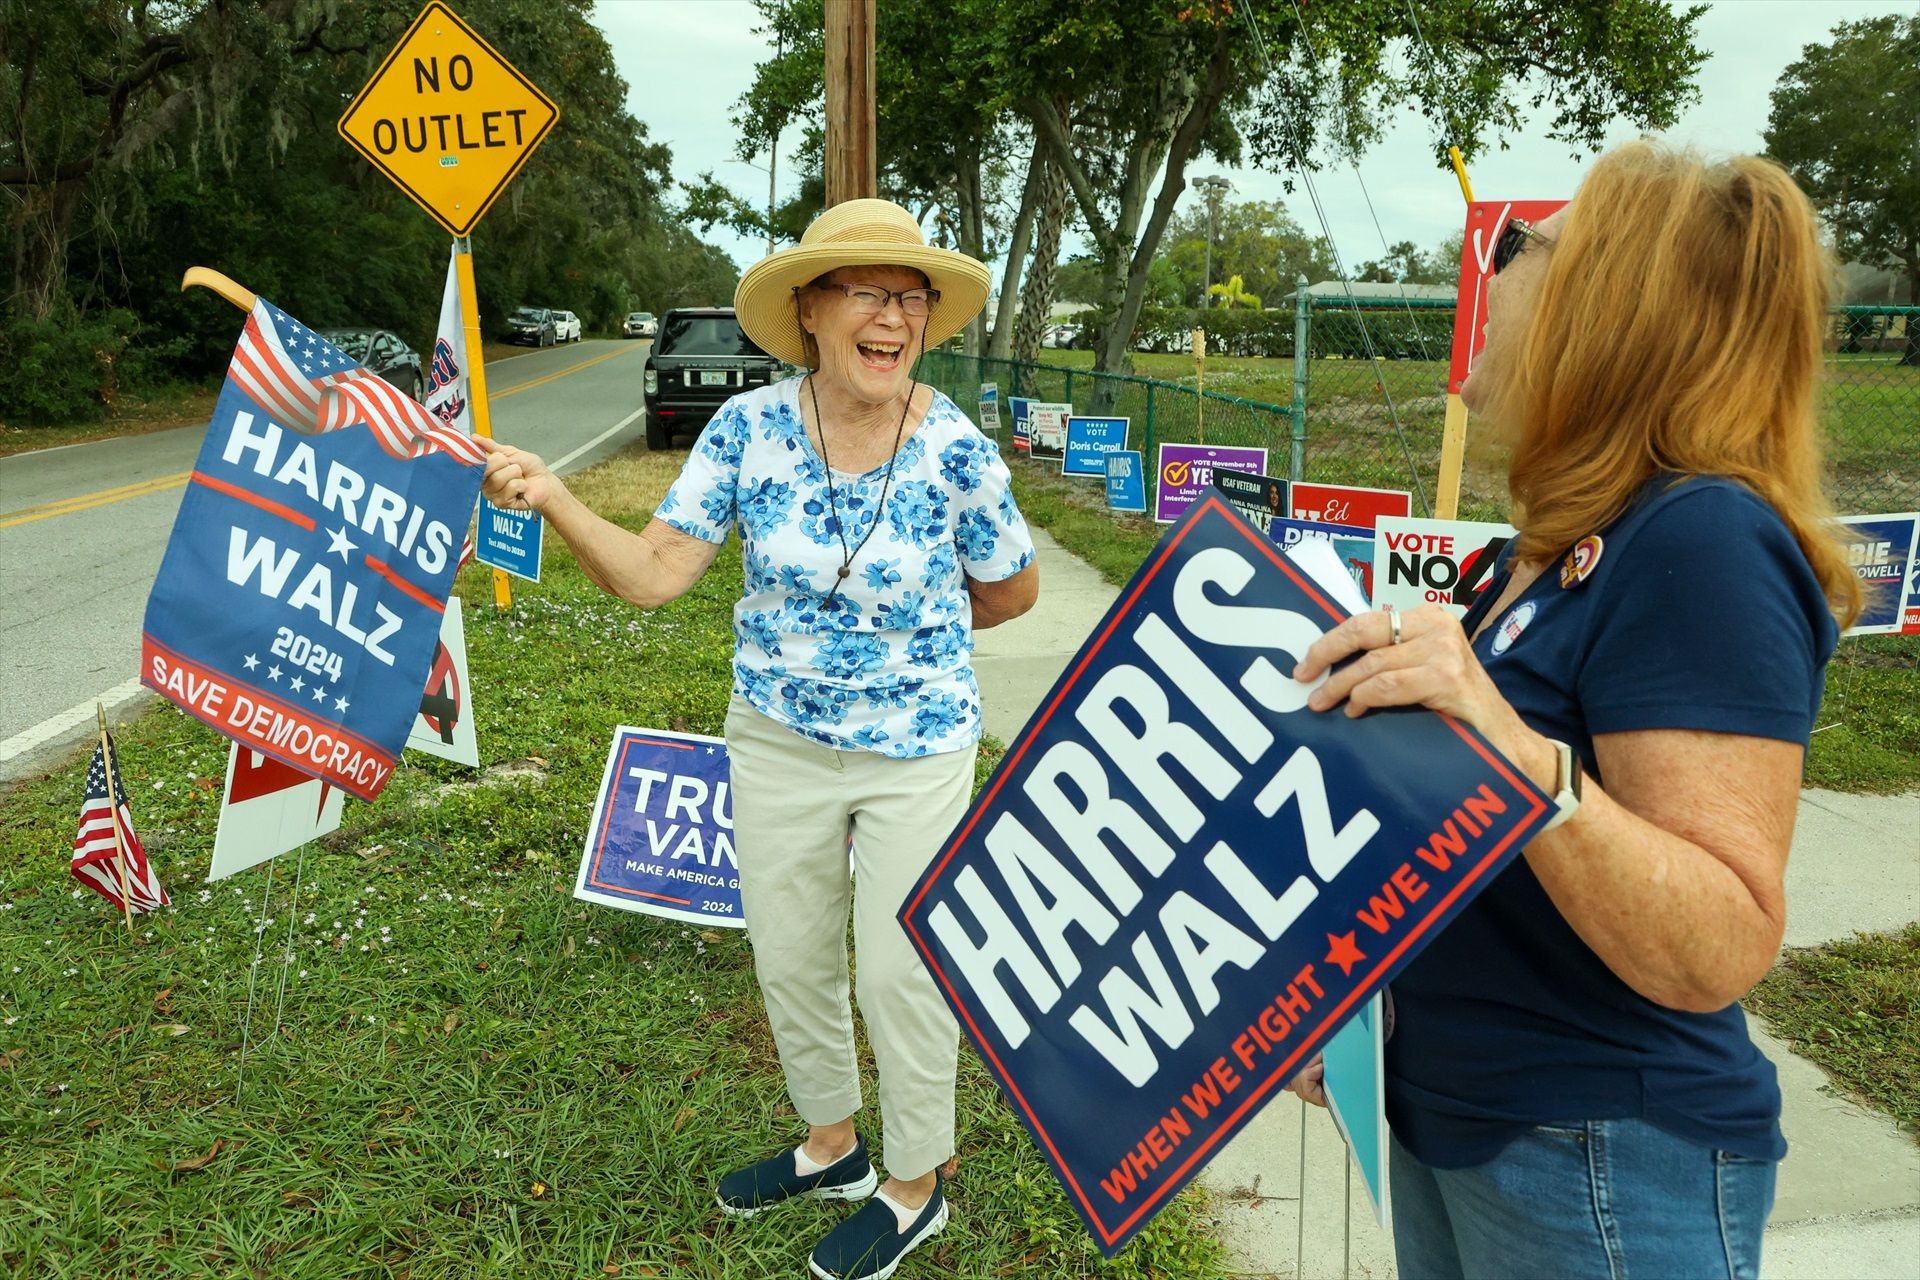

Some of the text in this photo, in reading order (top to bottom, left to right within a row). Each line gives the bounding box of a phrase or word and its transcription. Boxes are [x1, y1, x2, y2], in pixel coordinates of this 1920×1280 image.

[413, 54, 473, 94] NO
[373, 109, 527, 155] OUTLET
[1070, 441, 1121, 452] Doris Carroll
[222, 409, 453, 576] HARRIS
[1222, 477, 1261, 494] USAF VETERAN
[493, 514, 524, 541] WALZ
[1323, 499, 1350, 521] Ed
[1384, 531, 1454, 555] VOTE
[1388, 551, 1459, 591] NO
[227, 525, 404, 668] WALZ
[1424, 590, 1452, 605] ON
[270, 626, 344, 684] 2024
[152, 654, 390, 792] SAVE DEMOCRACY
[927, 547, 1332, 1050] HARRIS
[625, 858, 663, 877] MAKE
[665, 868, 726, 888] AMERICA
[701, 900, 733, 914] 2024
[1068, 745, 1381, 1089] WALZ
[1101, 783, 1508, 1205] WHEN WE FIGHT WE WIN
